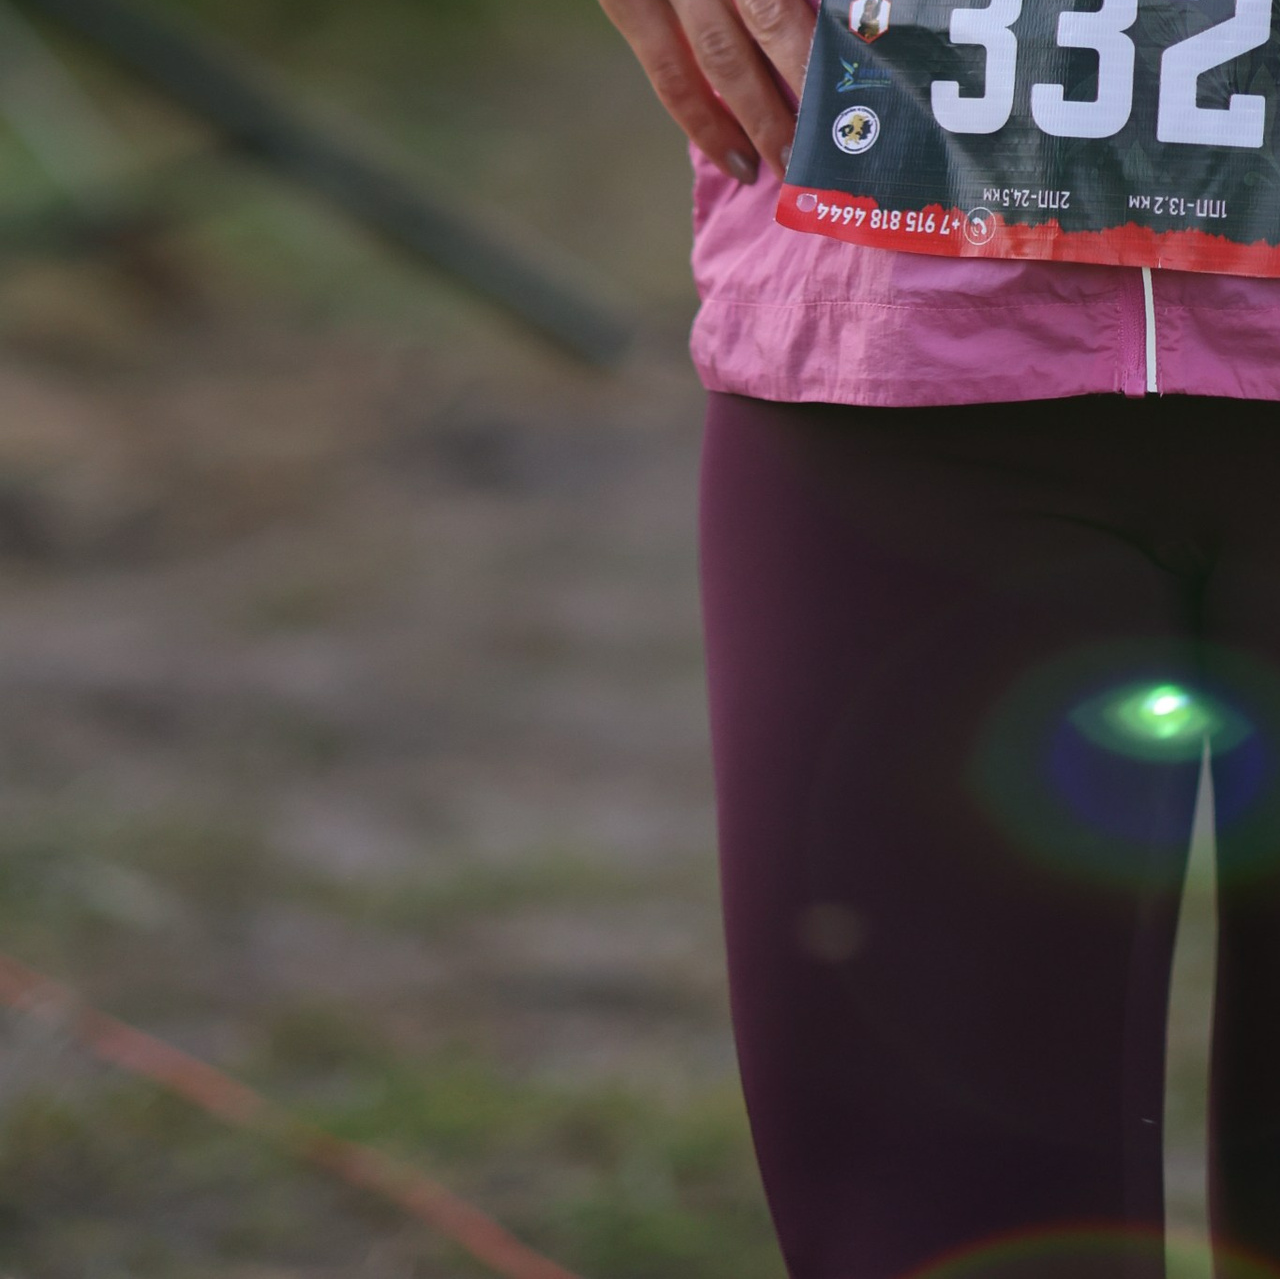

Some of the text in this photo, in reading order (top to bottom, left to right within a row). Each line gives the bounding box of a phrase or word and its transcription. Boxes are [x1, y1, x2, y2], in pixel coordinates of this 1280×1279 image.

[816, 202, 961, 235] +7 915 818 4644
